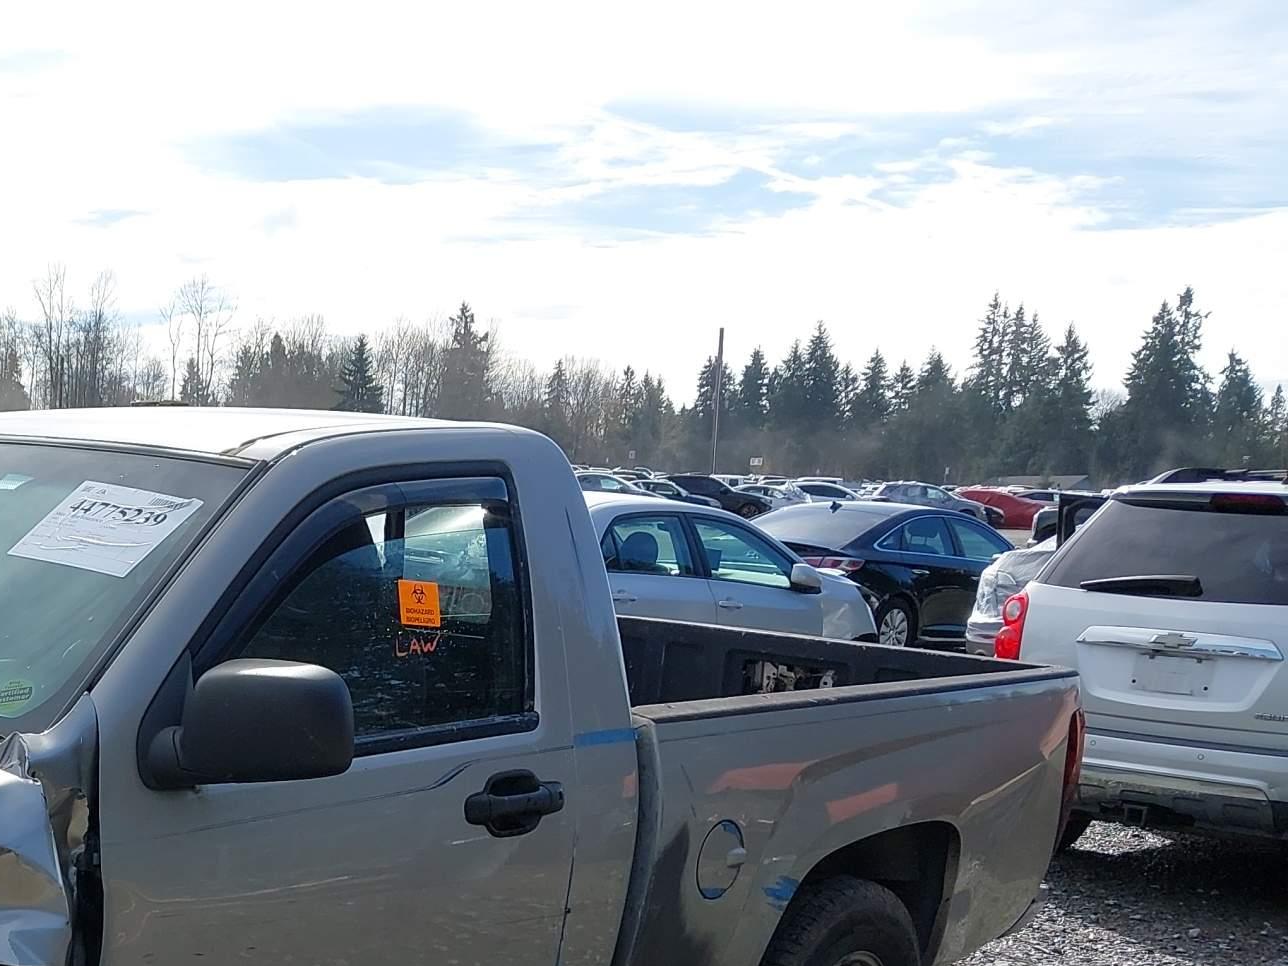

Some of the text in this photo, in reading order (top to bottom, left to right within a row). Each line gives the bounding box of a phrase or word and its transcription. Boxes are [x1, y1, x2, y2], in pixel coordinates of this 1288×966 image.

[69, 499, 169, 527] 44775239
[406, 607, 434, 615] BIOHAZARD
[395, 634, 441, 656] LAW
